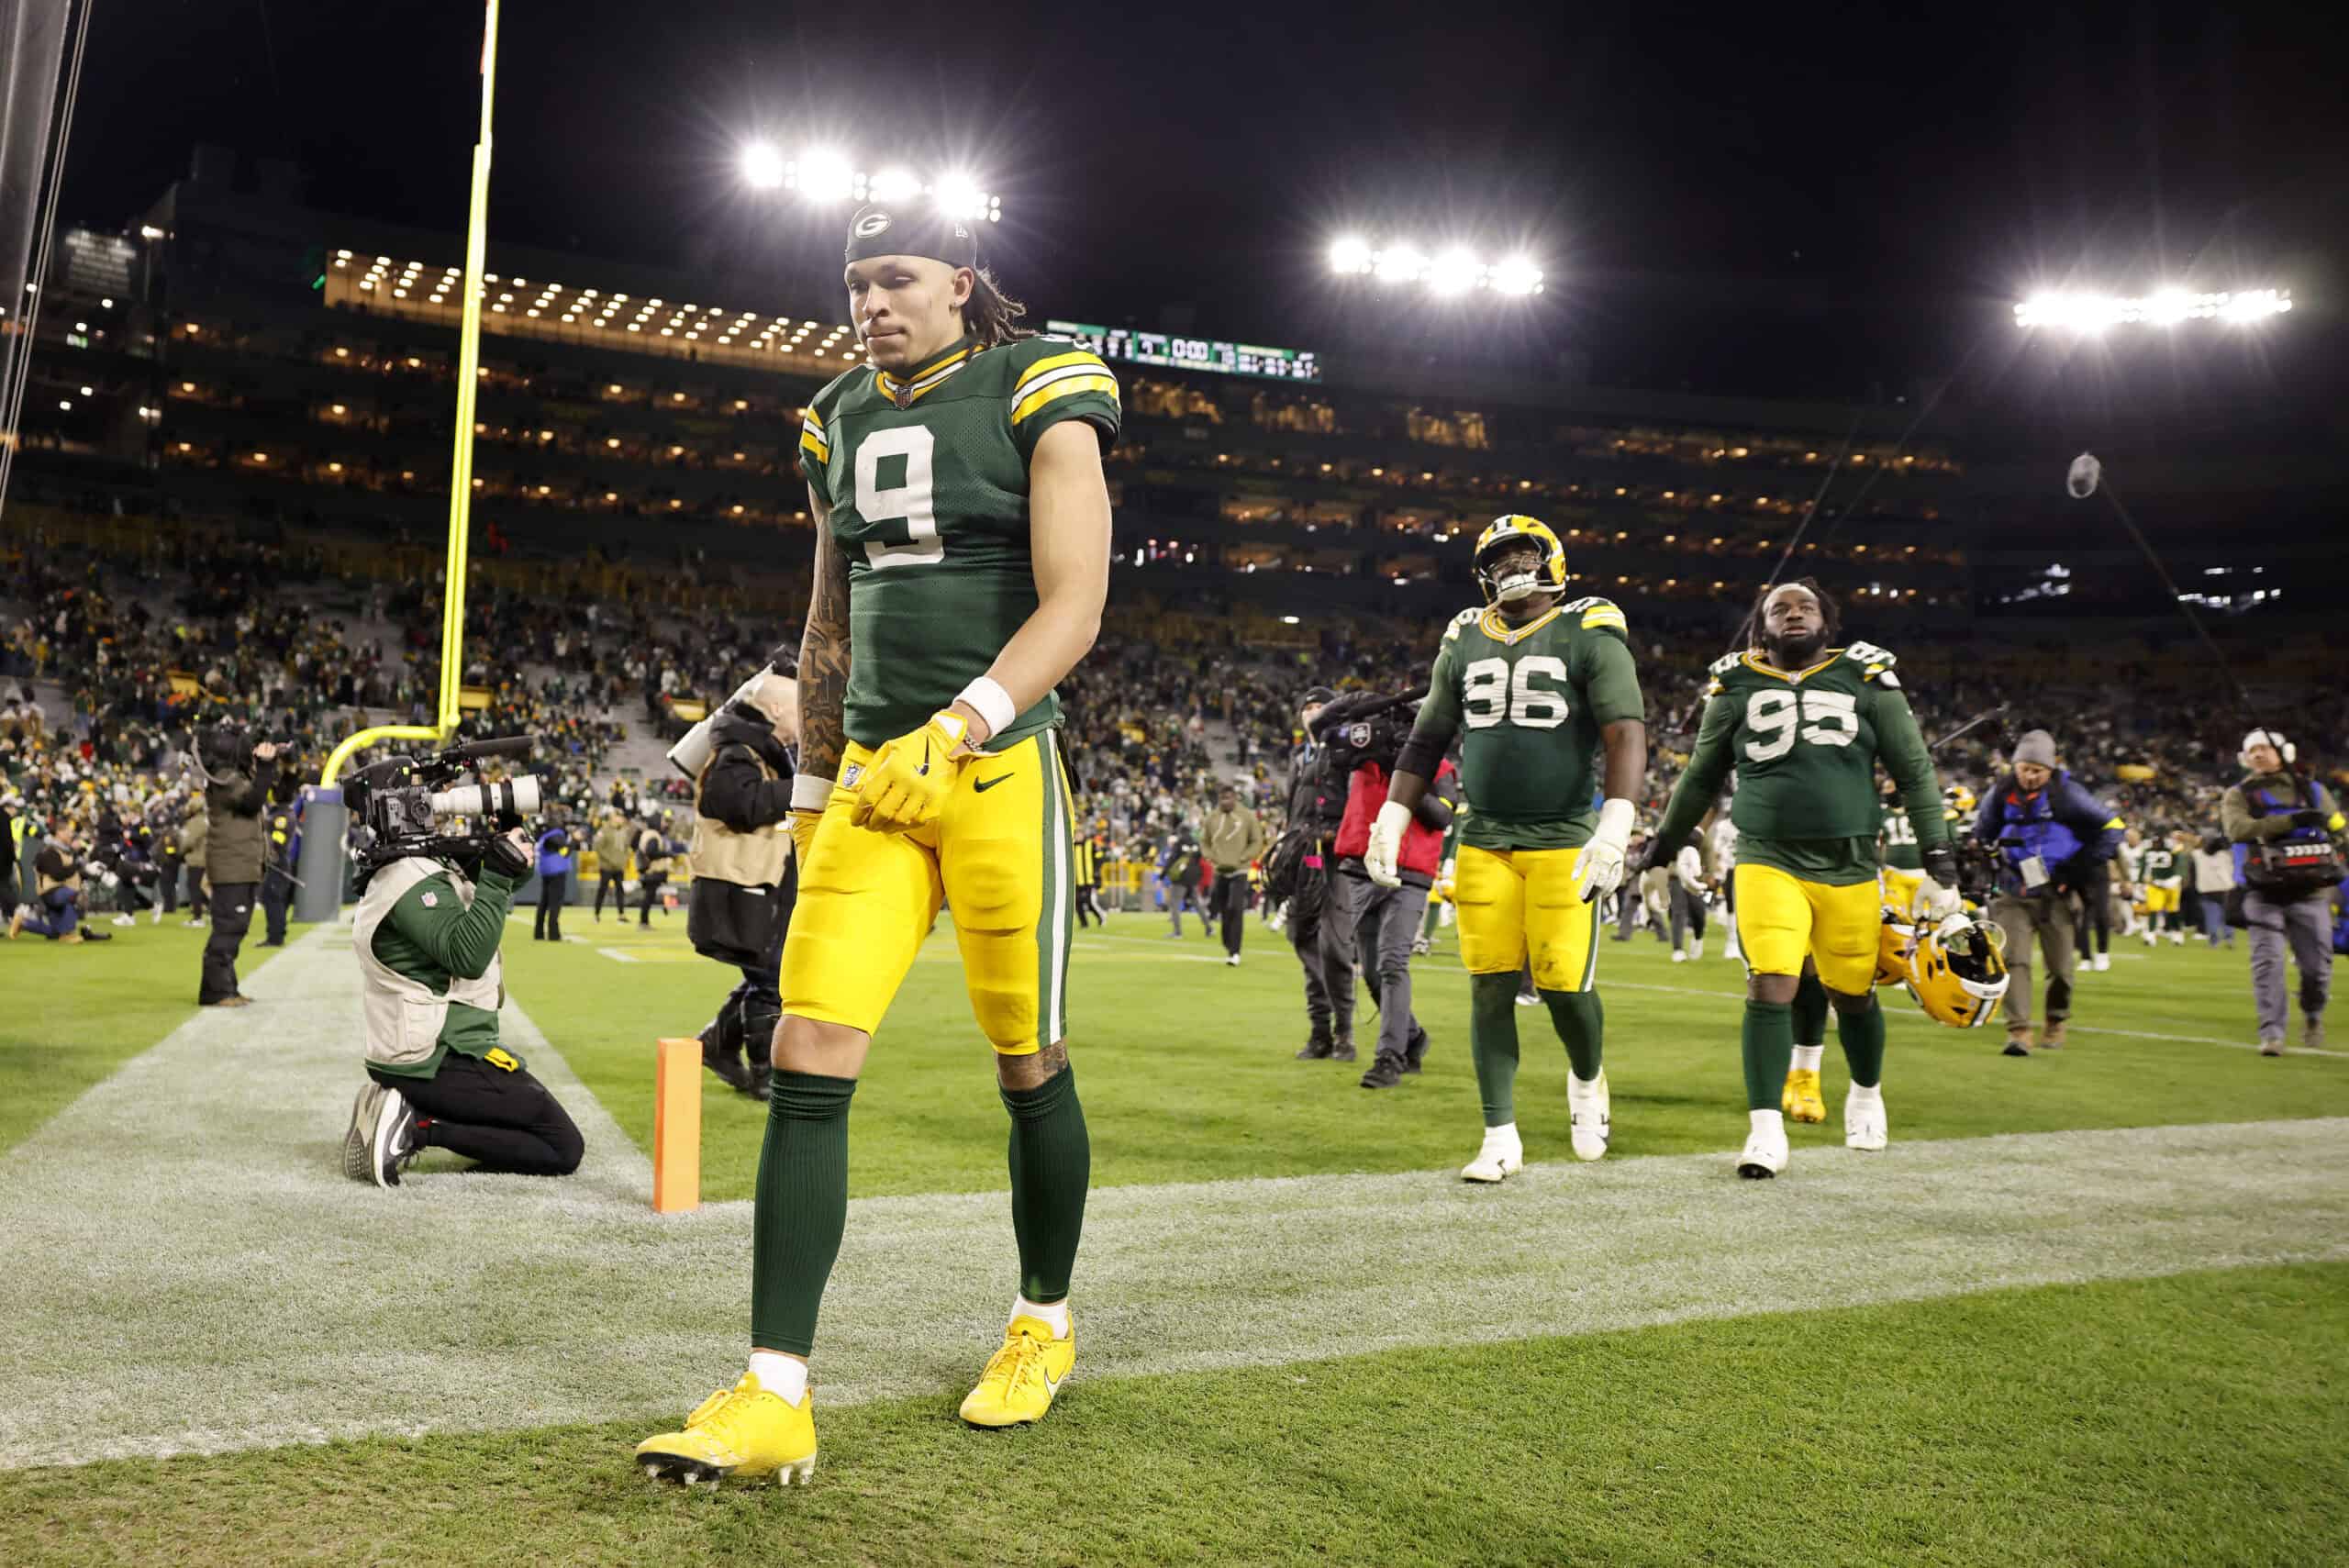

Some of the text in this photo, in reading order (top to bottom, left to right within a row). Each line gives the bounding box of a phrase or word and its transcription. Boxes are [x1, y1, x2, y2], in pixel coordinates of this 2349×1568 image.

[855, 425, 944, 569] 9
[1463, 655, 1569, 728] 96
[1745, 689, 1859, 762] 95
